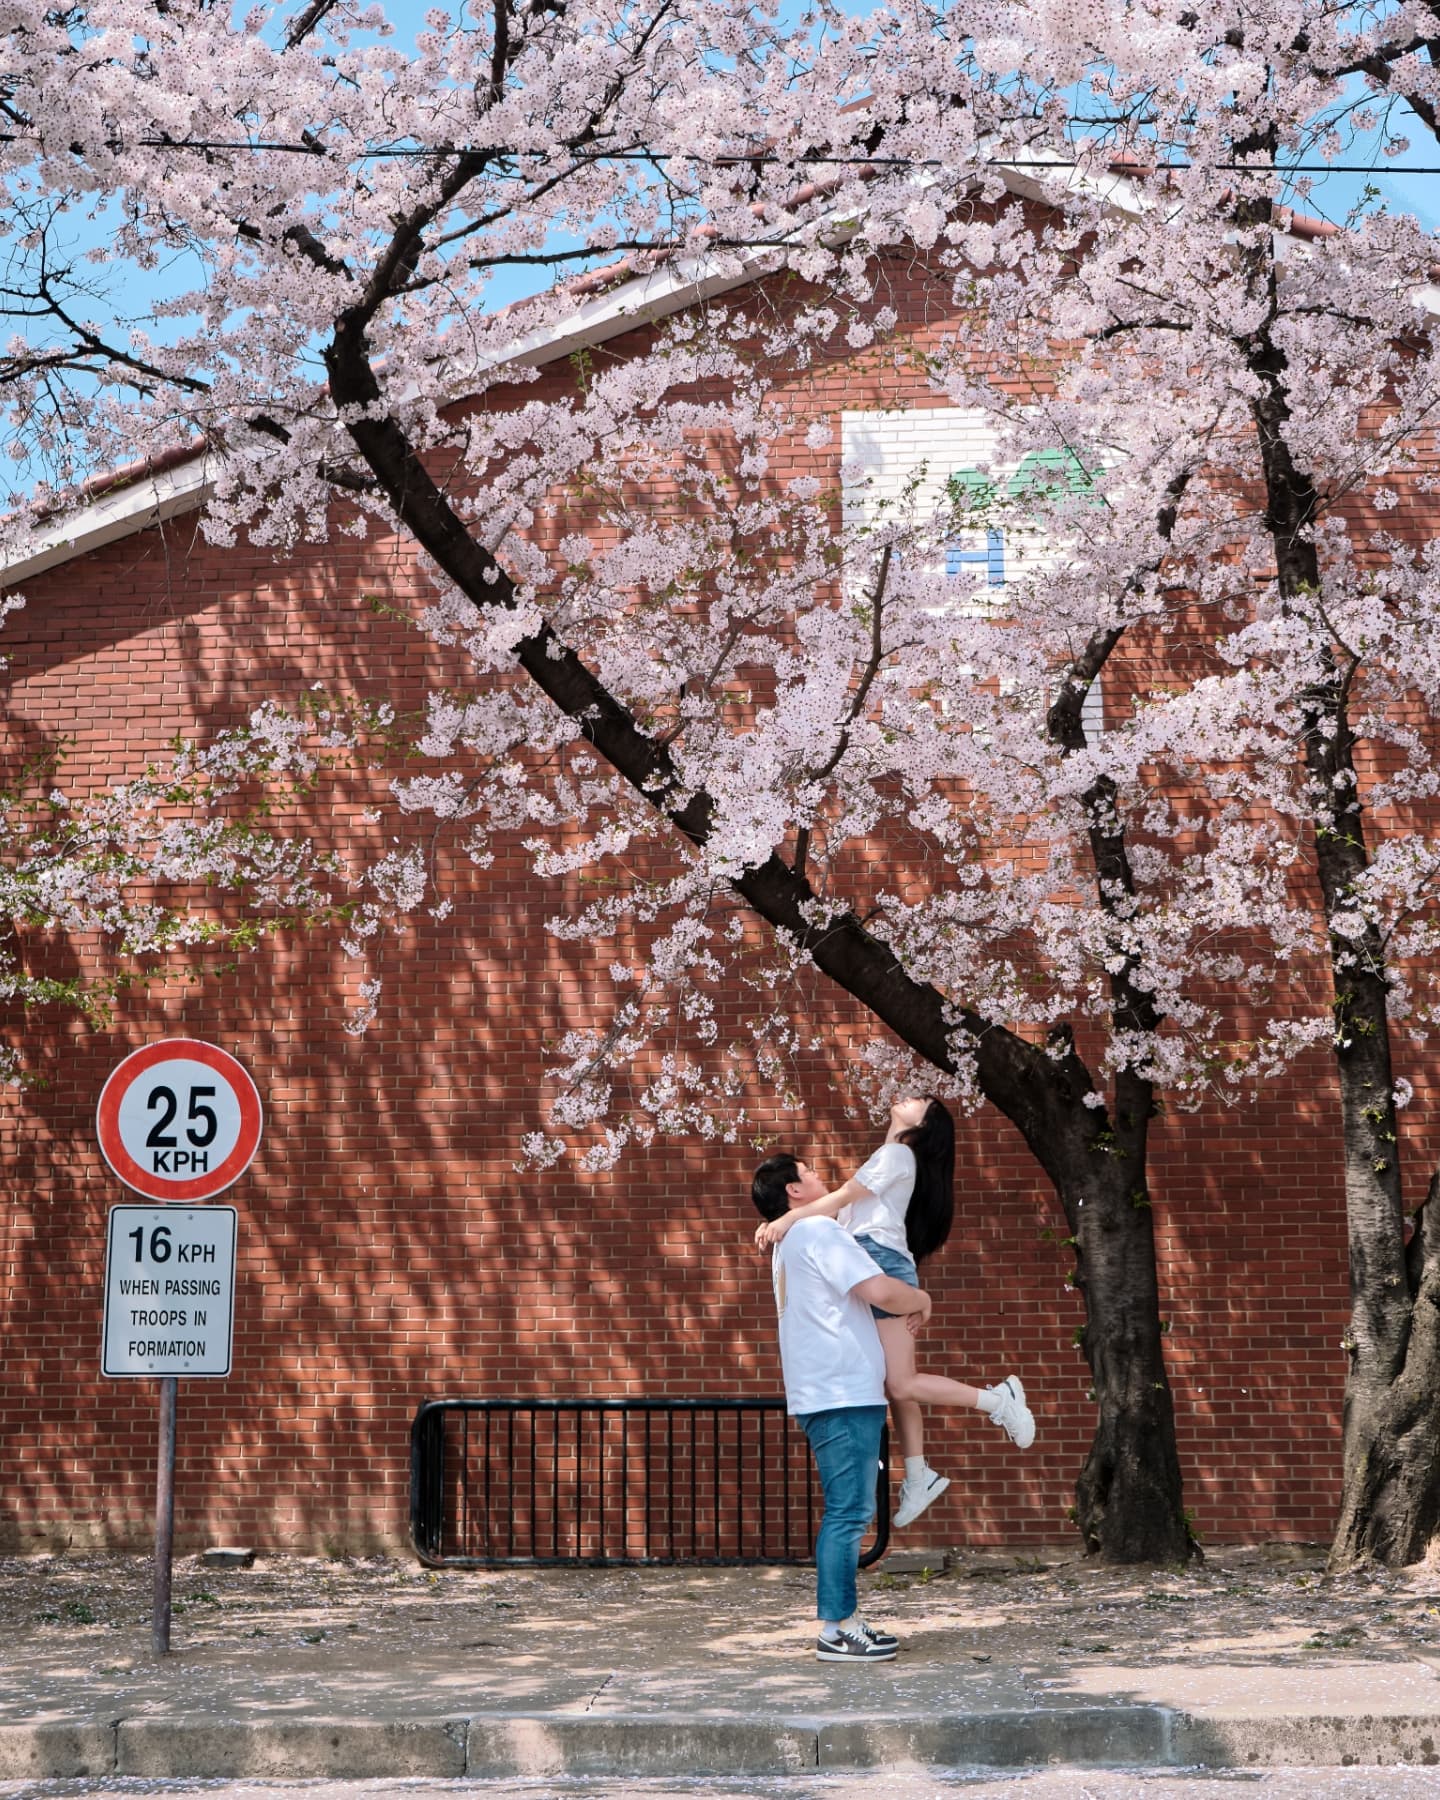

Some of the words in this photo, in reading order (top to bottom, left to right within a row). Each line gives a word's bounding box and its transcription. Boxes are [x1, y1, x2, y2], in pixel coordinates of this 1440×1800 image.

[145, 1085, 218, 1148] 25
[152, 1150, 209, 1173] KPH
[128, 1226, 172, 1264] 16
[177, 1244, 216, 1263] KPH
[119, 1279, 160, 1296] WHEN
[164, 1280, 221, 1296] PASSING
[130, 1310, 187, 1327] TROOPS
[194, 1310, 208, 1327] IN
[128, 1340, 206, 1357] FORMATION
